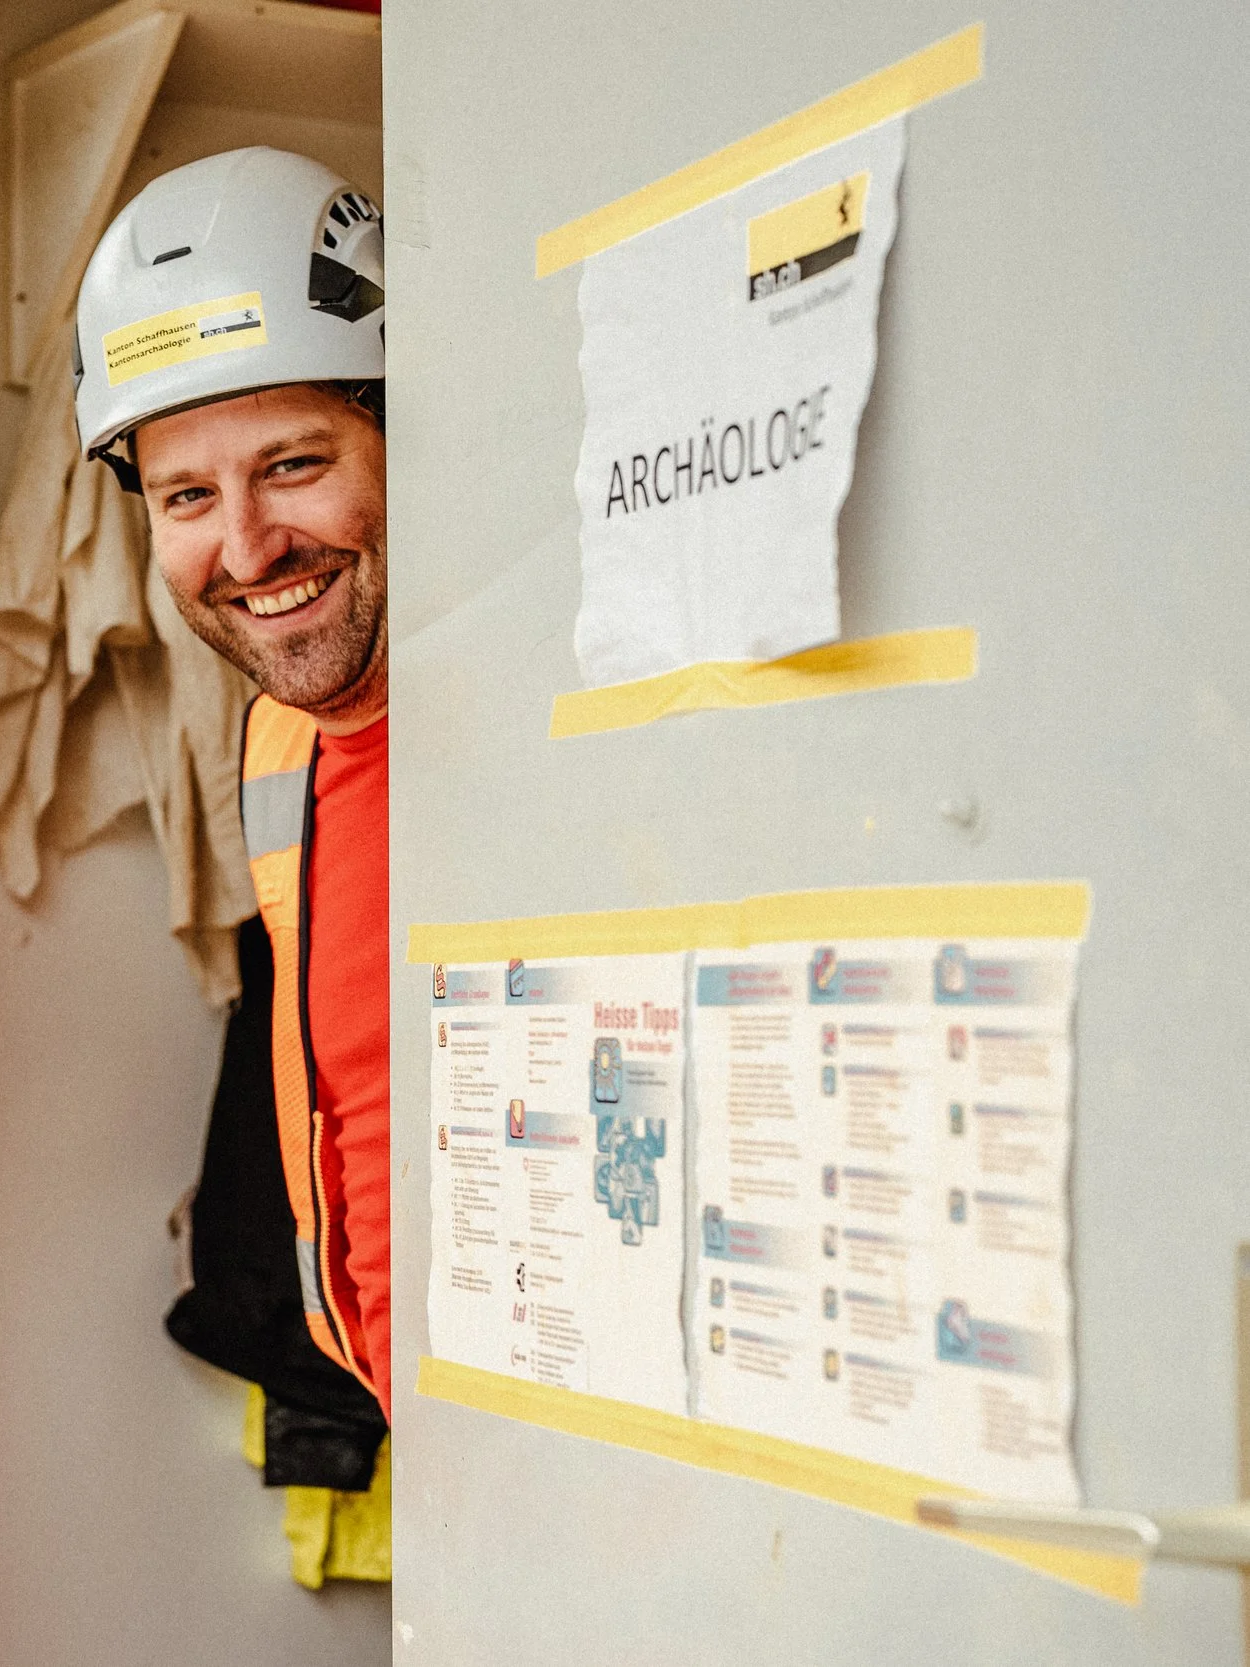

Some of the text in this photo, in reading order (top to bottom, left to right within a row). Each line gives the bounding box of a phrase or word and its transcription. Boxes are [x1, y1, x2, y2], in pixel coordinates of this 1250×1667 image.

[107, 321, 197, 357] Kanton Schaffhausen
[606, 384, 831, 518] ARCHÄOLOGIE
[594, 1001, 679, 1037] Heisse Tipps
